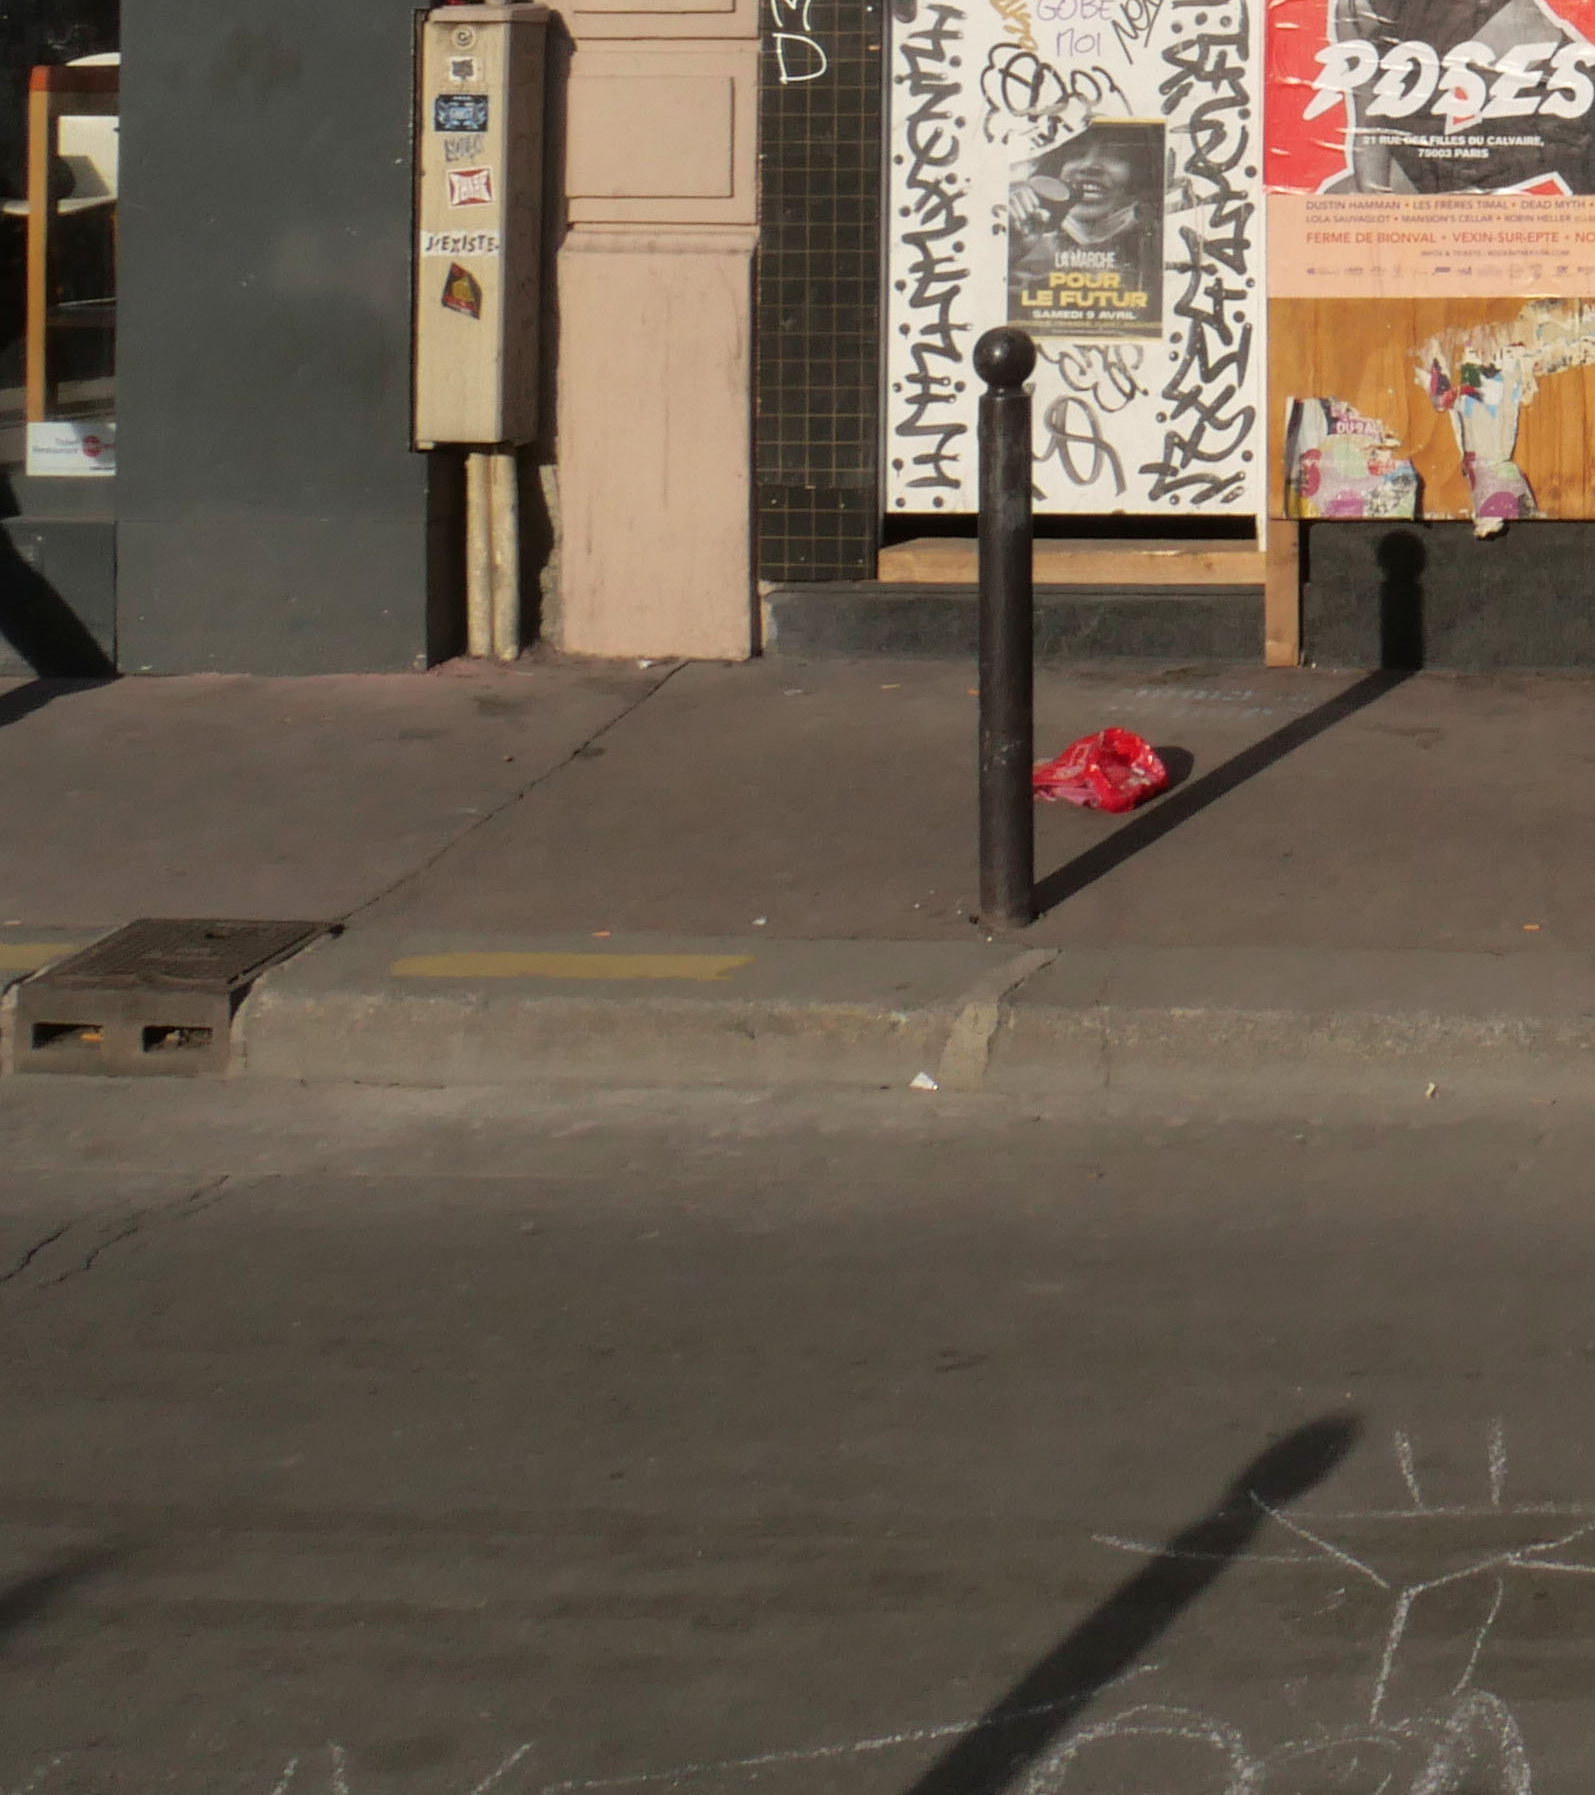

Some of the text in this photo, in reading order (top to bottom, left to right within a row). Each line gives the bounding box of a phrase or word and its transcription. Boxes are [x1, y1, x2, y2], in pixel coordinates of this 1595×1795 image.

[1073, 251, 1116, 269] MARCHE
[1049, 271, 1120, 289] POUR
[1022, 291, 1149, 309] LE FUTUR
[1032, 310, 1083, 321] SAMEDI
[1098, 310, 1137, 321] AVRIL
